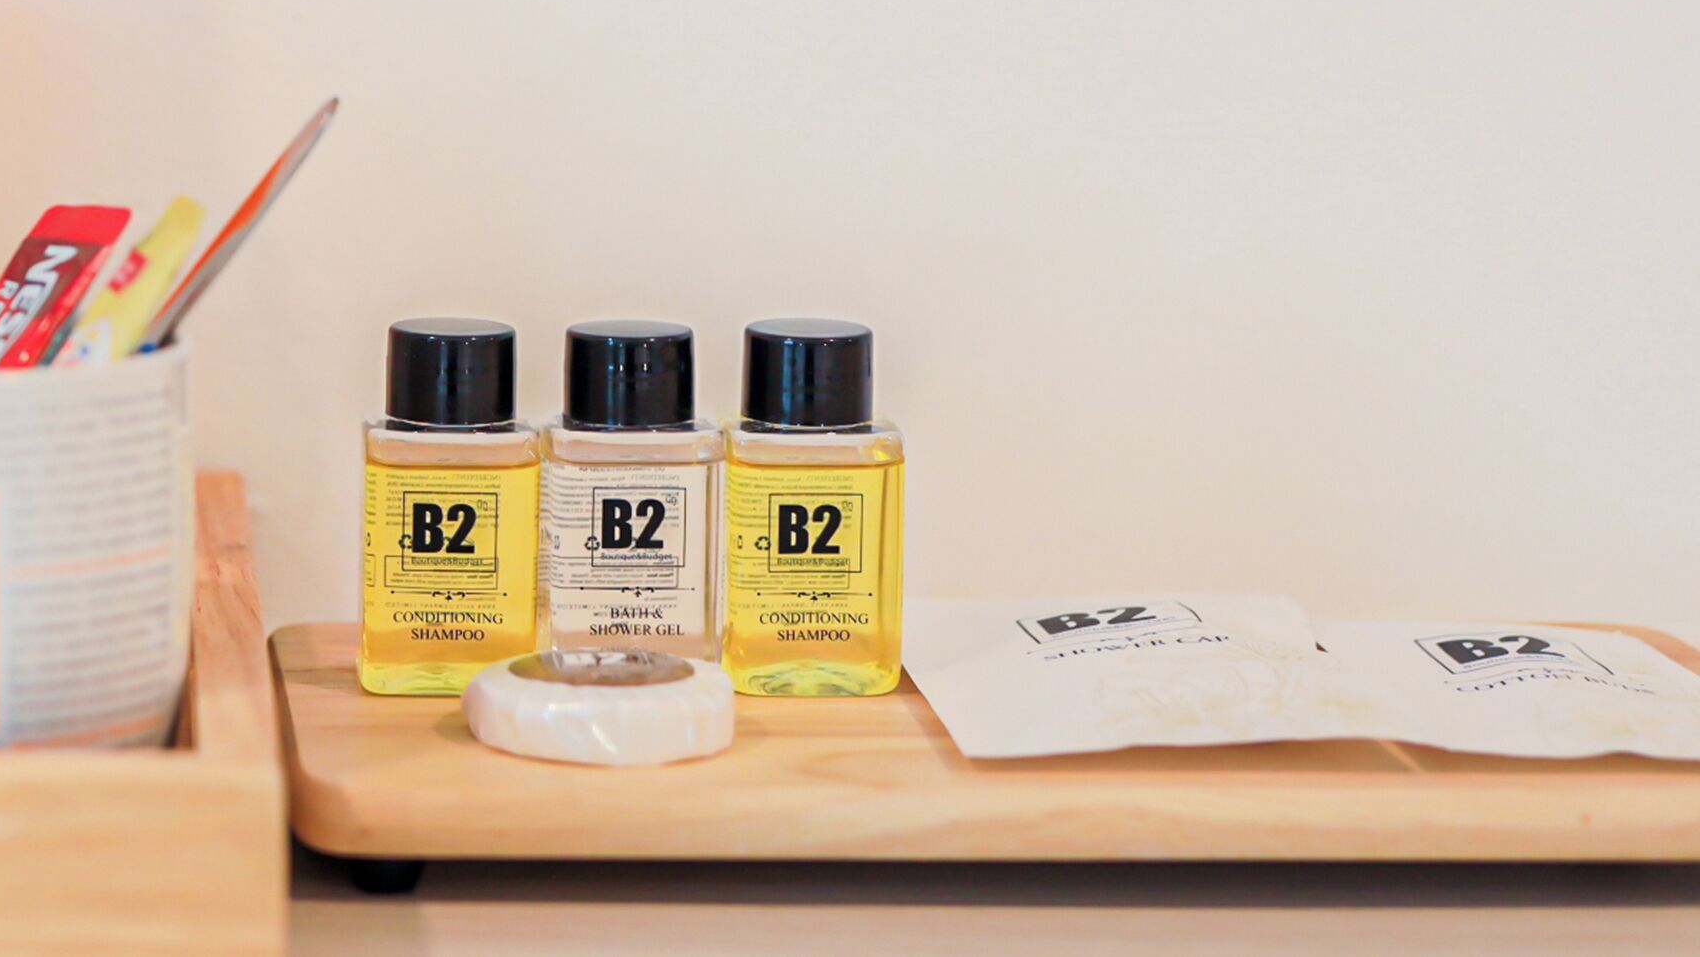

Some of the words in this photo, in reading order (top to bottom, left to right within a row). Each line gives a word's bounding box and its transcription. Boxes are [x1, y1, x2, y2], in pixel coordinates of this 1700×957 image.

[412, 503, 477, 553] B2
[601, 498, 666, 549] B2
[778, 504, 842, 554] B2
[393, 610, 503, 625] CONDITIONING
[610, 607, 648, 619] BATH
[652, 608, 664, 619] &
[759, 612, 869, 625] CONDITIONING
[1037, 606, 1157, 635] B2
[411, 628, 485, 641] SHAMPOO
[589, 624, 652, 636] SHOWER
[656, 624, 685, 636] GEL
[777, 629, 851, 642] SHAMPOO
[1043, 640, 1166, 660] SHOWER
[1436, 635, 1566, 665] B2
[1456, 672, 1572, 692] COTTON
